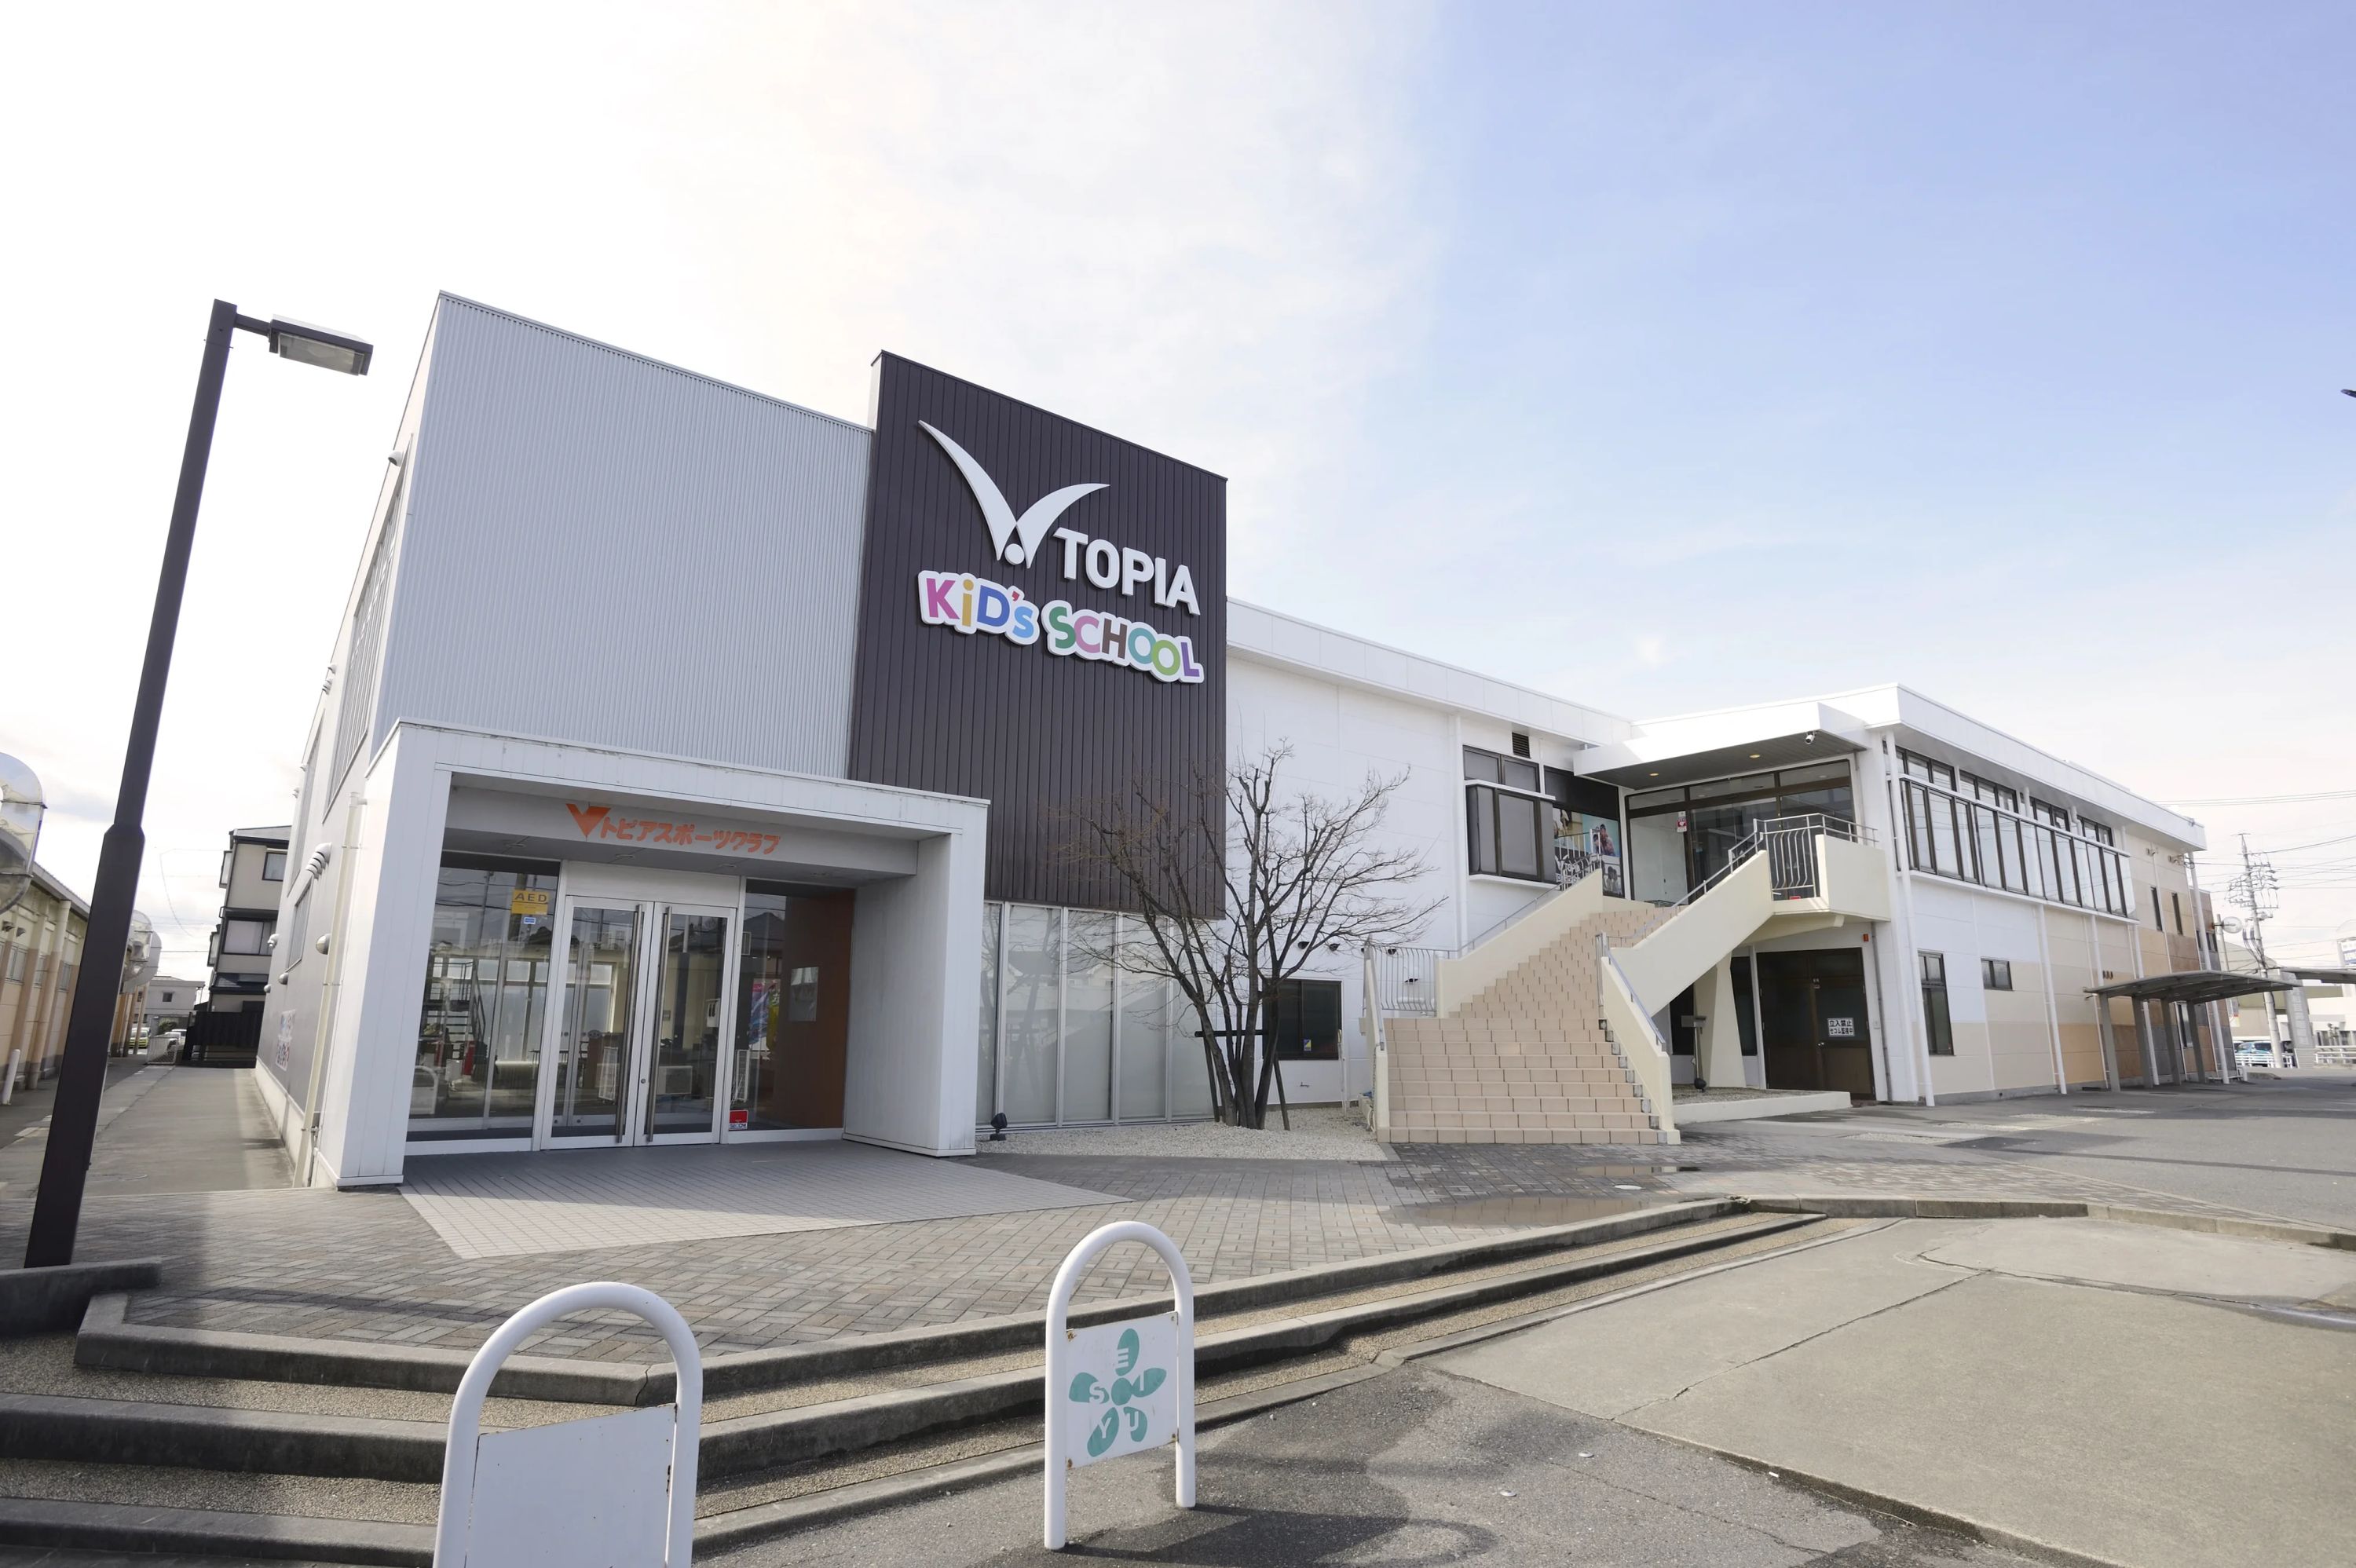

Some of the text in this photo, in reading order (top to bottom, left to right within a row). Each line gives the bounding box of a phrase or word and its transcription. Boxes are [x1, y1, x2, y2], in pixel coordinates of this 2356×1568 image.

[1052, 526, 1201, 616] TOPIA
[1048, 605, 1201, 678] SCHOOL
[514, 892, 547, 902] AED
